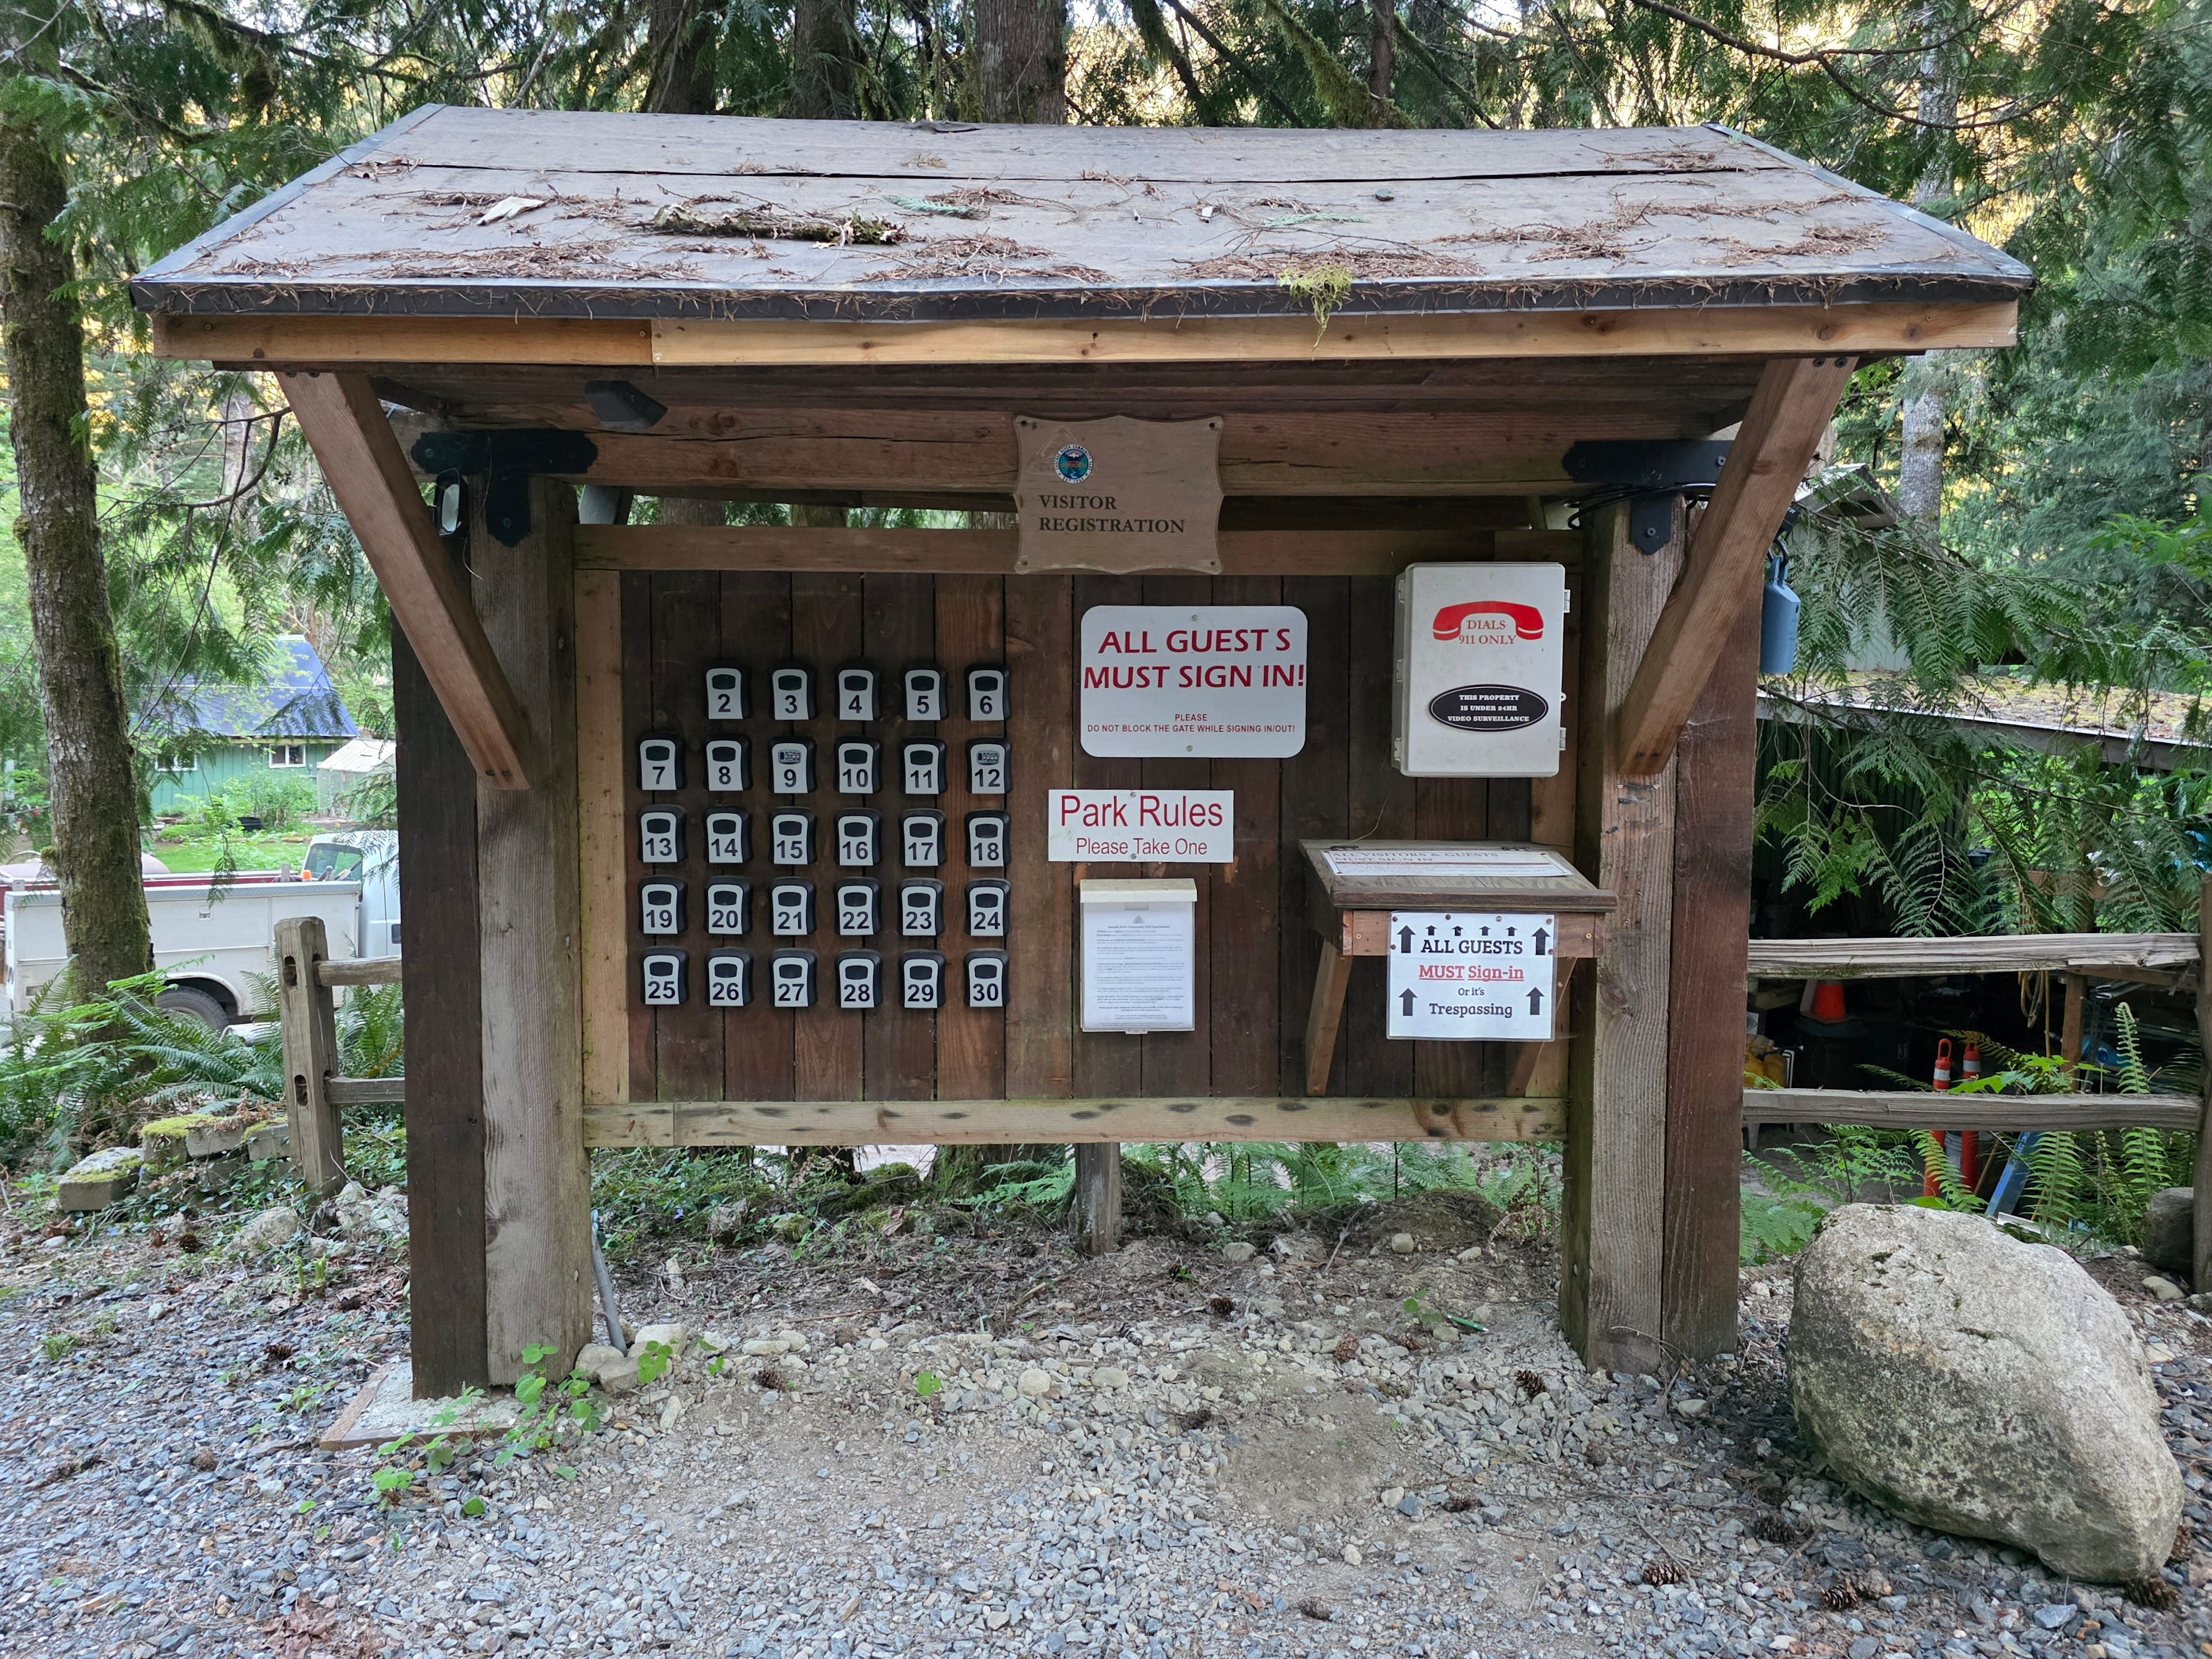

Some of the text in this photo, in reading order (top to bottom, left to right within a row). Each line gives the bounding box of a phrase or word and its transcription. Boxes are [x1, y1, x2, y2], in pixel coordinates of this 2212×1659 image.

[1038, 494, 1118, 510] VISITOR
[1039, 517, 1185, 533] REGISTRATION
[1467, 620, 1506, 630] DIALS
[1098, 631, 1157, 654] ALL
[1459, 635, 1516, 645] 911 ONLY
[1084, 664, 1304, 689] MUST SIGN IN!
[717, 694, 731, 713] 2
[785, 695, 798, 714] 3
[849, 694, 862, 714] 4
[916, 695, 930, 714] 5
[979, 695, 993, 715] 6
[1088, 724, 1100, 732] DO
[1122, 724, 1152, 732] BLOCK
[1226, 725, 1262, 733] SIGNING
[1264, 725, 1295, 733] IN/OUT!
[652, 766, 665, 785] 7
[718, 766, 732, 785] 8
[783, 768, 797, 787] 9
[842, 768, 868, 787] 10
[910, 770, 932, 789] 11
[975, 768, 1001, 787] 12
[1061, 795, 1223, 827] Park Rules
[645, 838, 672, 857] 13
[711, 838, 738, 857] 14
[777, 840, 803, 859] 15
[842, 841, 868, 860] 16
[908, 842, 934, 861] 17
[974, 842, 999, 861] 18
[1077, 838, 1207, 855] Please Take One
[646, 910, 672, 928] 19
[711, 910, 738, 929] 20
[778, 911, 802, 930] 21
[843, 911, 869, 930] 22
[906, 911, 932, 930] 23
[974, 911, 1001, 930] 24
[1421, 939, 1523, 955] ALL GUESTS
[1418, 964, 1524, 982] MUST Sign-in
[647, 980, 676, 999] 25
[712, 982, 739, 1001] 26
[778, 983, 805, 1001] 27
[843, 984, 870, 1002] 28
[907, 984, 934, 1002] 29
[973, 983, 999, 1002] 30
[1458, 987, 1485, 996] Or it's
[1429, 1003, 1513, 1018] Trespassing
